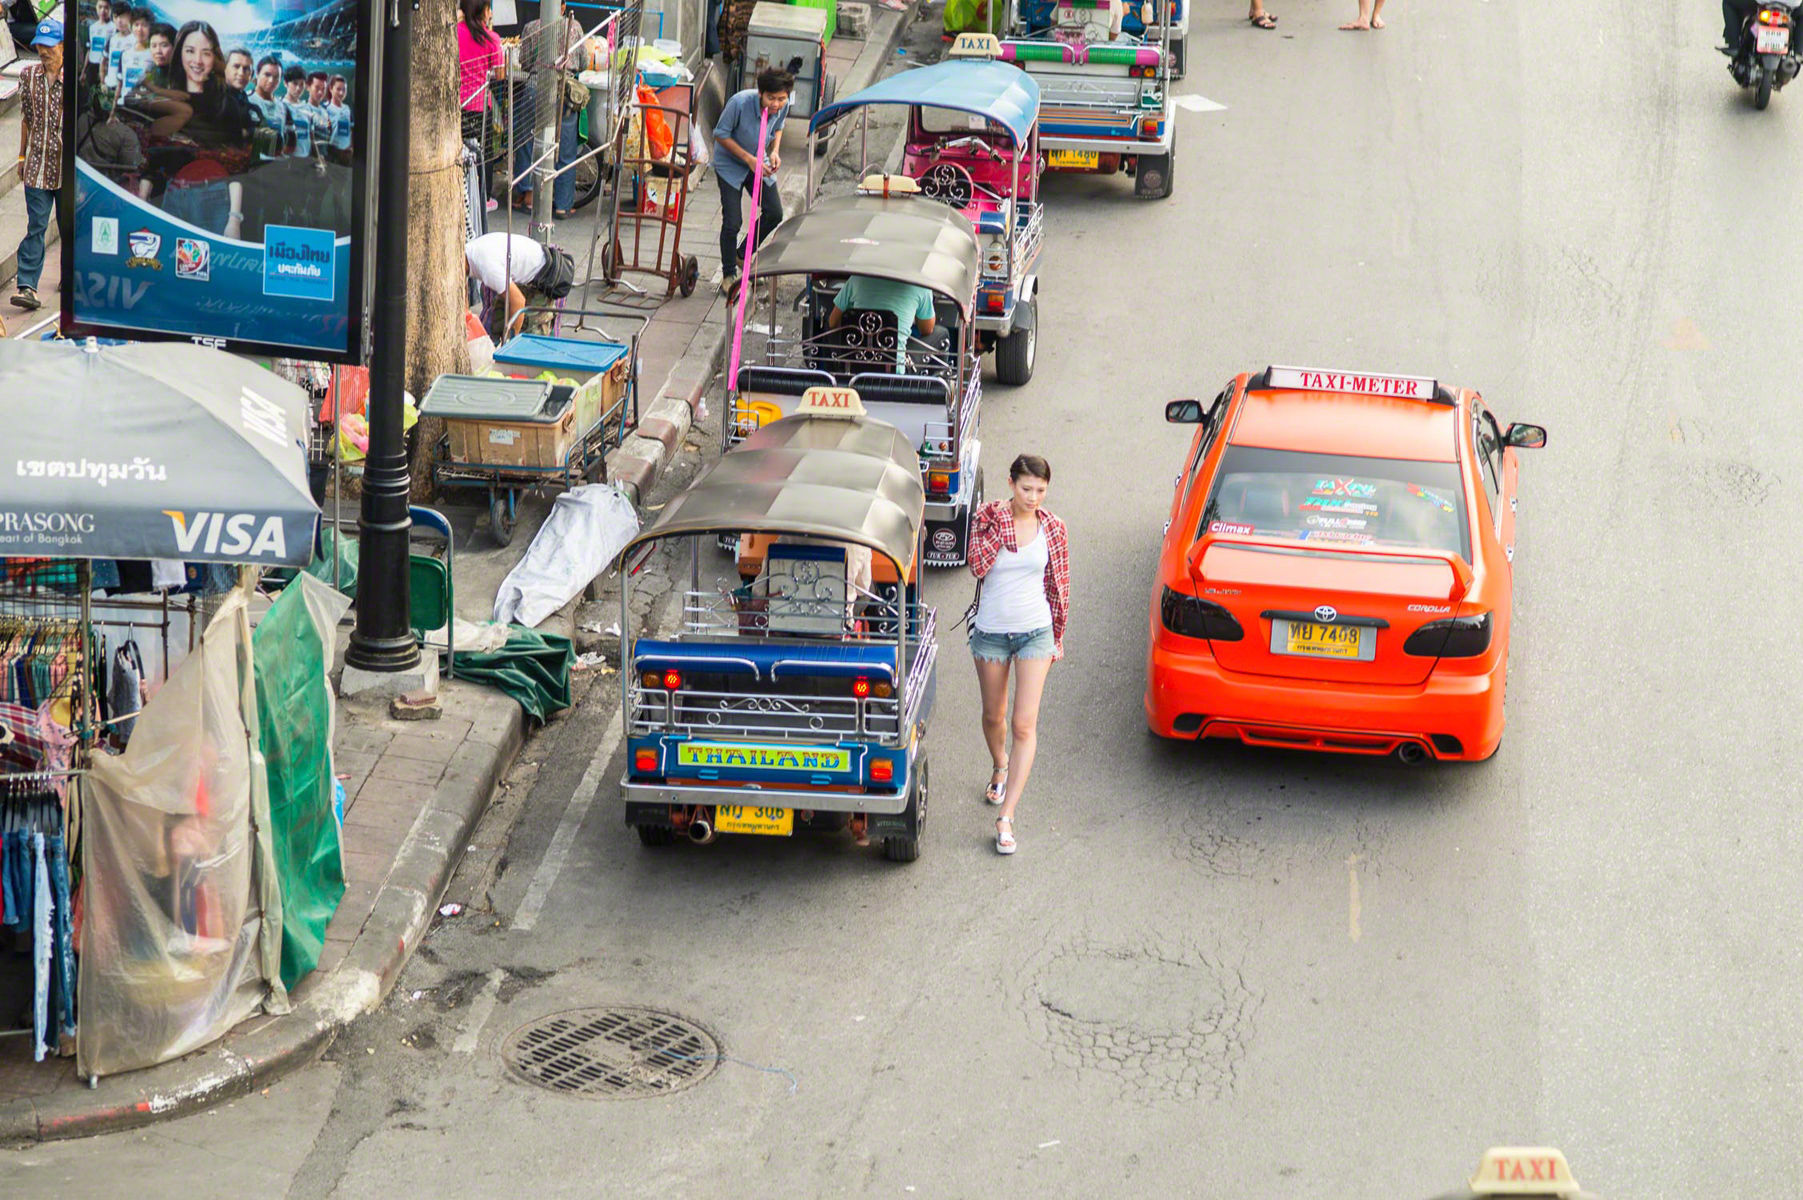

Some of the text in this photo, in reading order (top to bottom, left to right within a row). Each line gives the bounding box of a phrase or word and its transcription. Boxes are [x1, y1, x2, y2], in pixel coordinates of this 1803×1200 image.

[960, 37, 990, 50] TAXI
[269, 241, 331, 263] เมืองไทย
[277, 262, 321, 277] ประกันภัย
[1300, 372, 1418, 396] TAXI-METER
[808, 391, 850, 408] TAXI
[240, 385, 288, 448] VISA
[16, 457, 167, 487] เขตปทุมวัน
[161, 509, 287, 558] VISA
[1211, 522, 1251, 535] Climax
[23, 533, 34, 544] of
[38, 533, 83, 547] Bangkok
[687, 746, 840, 769] THAILAND
[1493, 1157, 1558, 1181] TAXI
